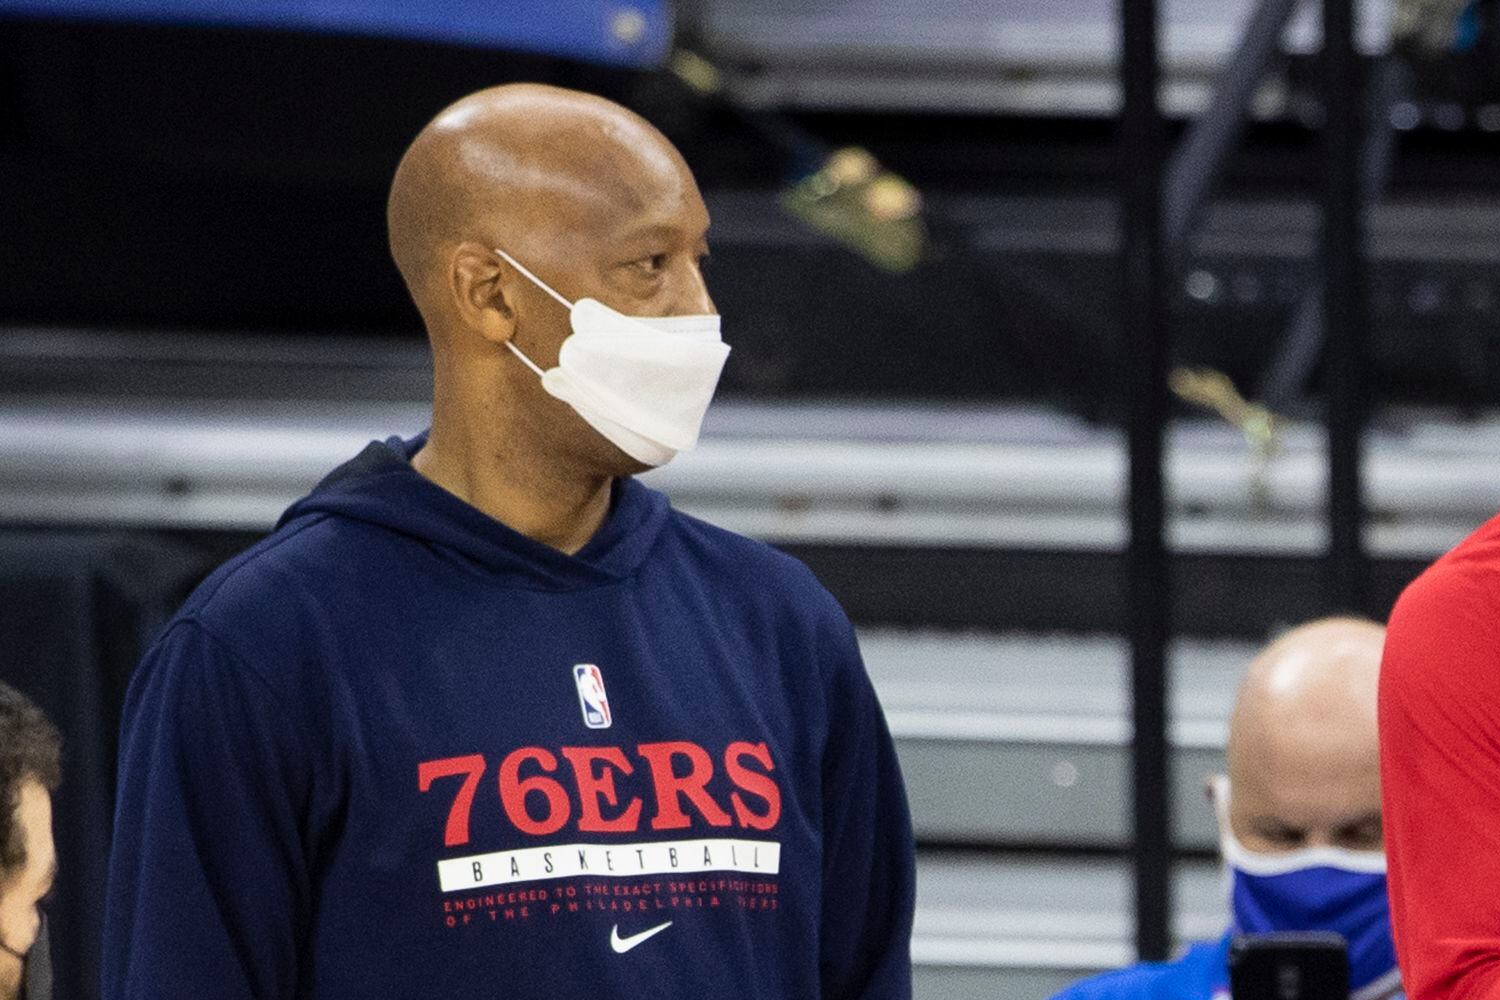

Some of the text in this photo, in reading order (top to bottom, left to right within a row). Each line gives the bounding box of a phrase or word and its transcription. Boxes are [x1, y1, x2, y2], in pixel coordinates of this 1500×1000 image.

[417, 740, 782, 847] 76ERS
[472, 845, 760, 882] BASKETBALL
[556, 886, 577, 898] TO
